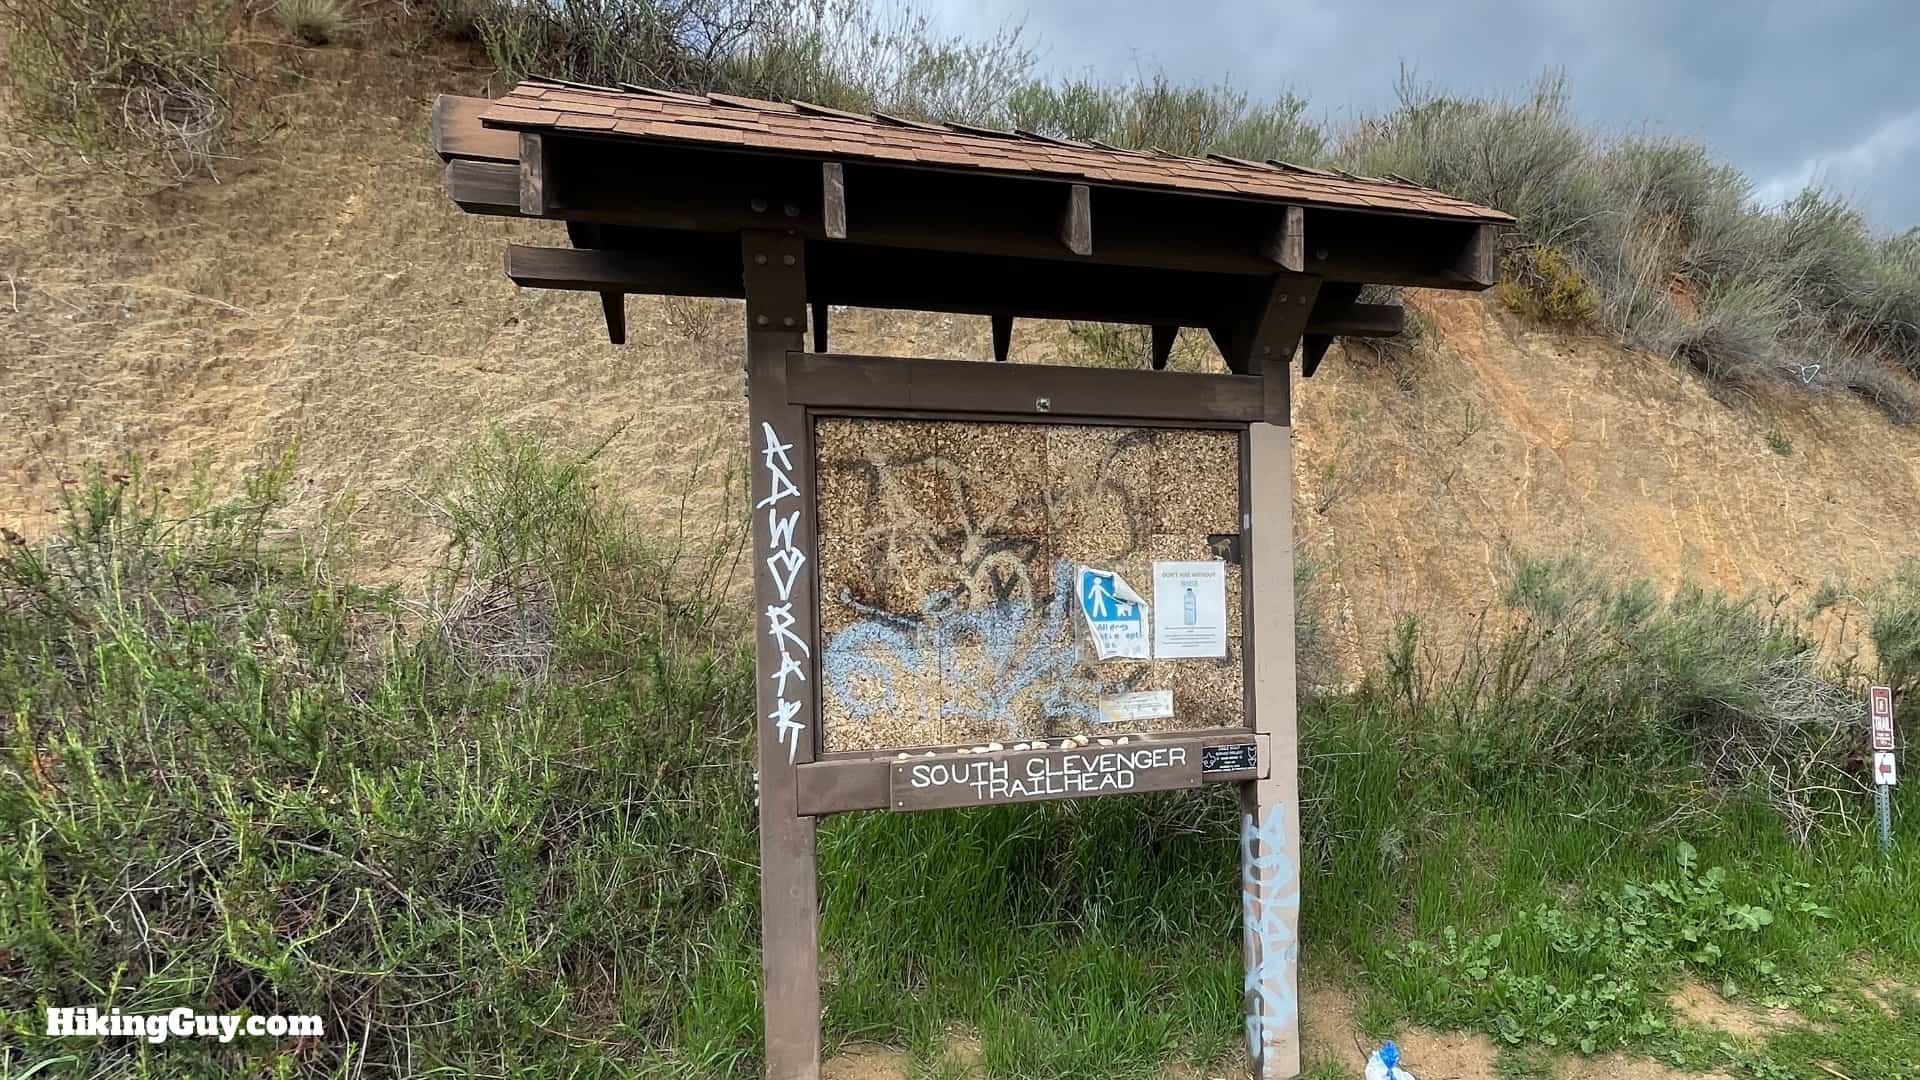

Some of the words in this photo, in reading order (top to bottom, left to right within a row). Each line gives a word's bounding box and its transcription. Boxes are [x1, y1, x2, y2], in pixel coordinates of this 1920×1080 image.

[911, 760, 1009, 788] SOUTH
[1026, 747, 1186, 778] CLEVENGER
[970, 769, 1135, 800] TRAILHEAD
